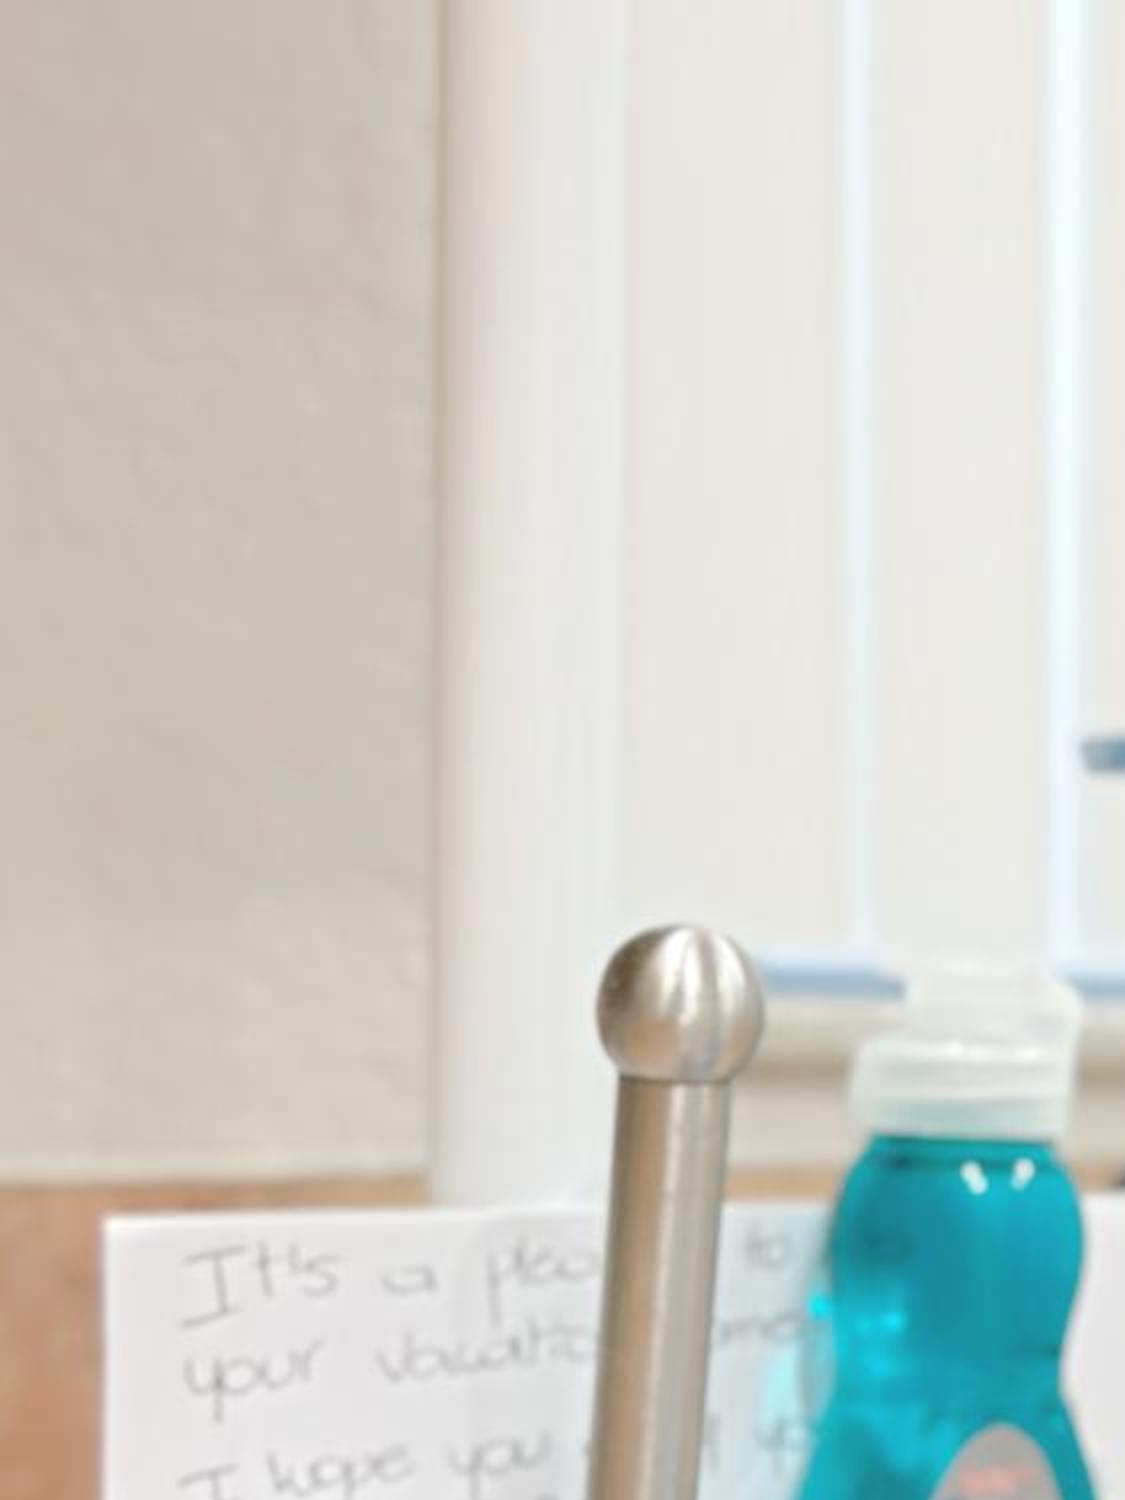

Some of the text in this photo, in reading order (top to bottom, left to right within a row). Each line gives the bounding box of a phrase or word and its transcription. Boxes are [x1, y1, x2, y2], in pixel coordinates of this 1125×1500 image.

[180, 1242, 342, 1328] It's
[382, 1262, 438, 1296] a
[745, 1224, 790, 1271] to
[183, 1338, 324, 1422] your
[375, 1318, 598, 1382] vacatio
